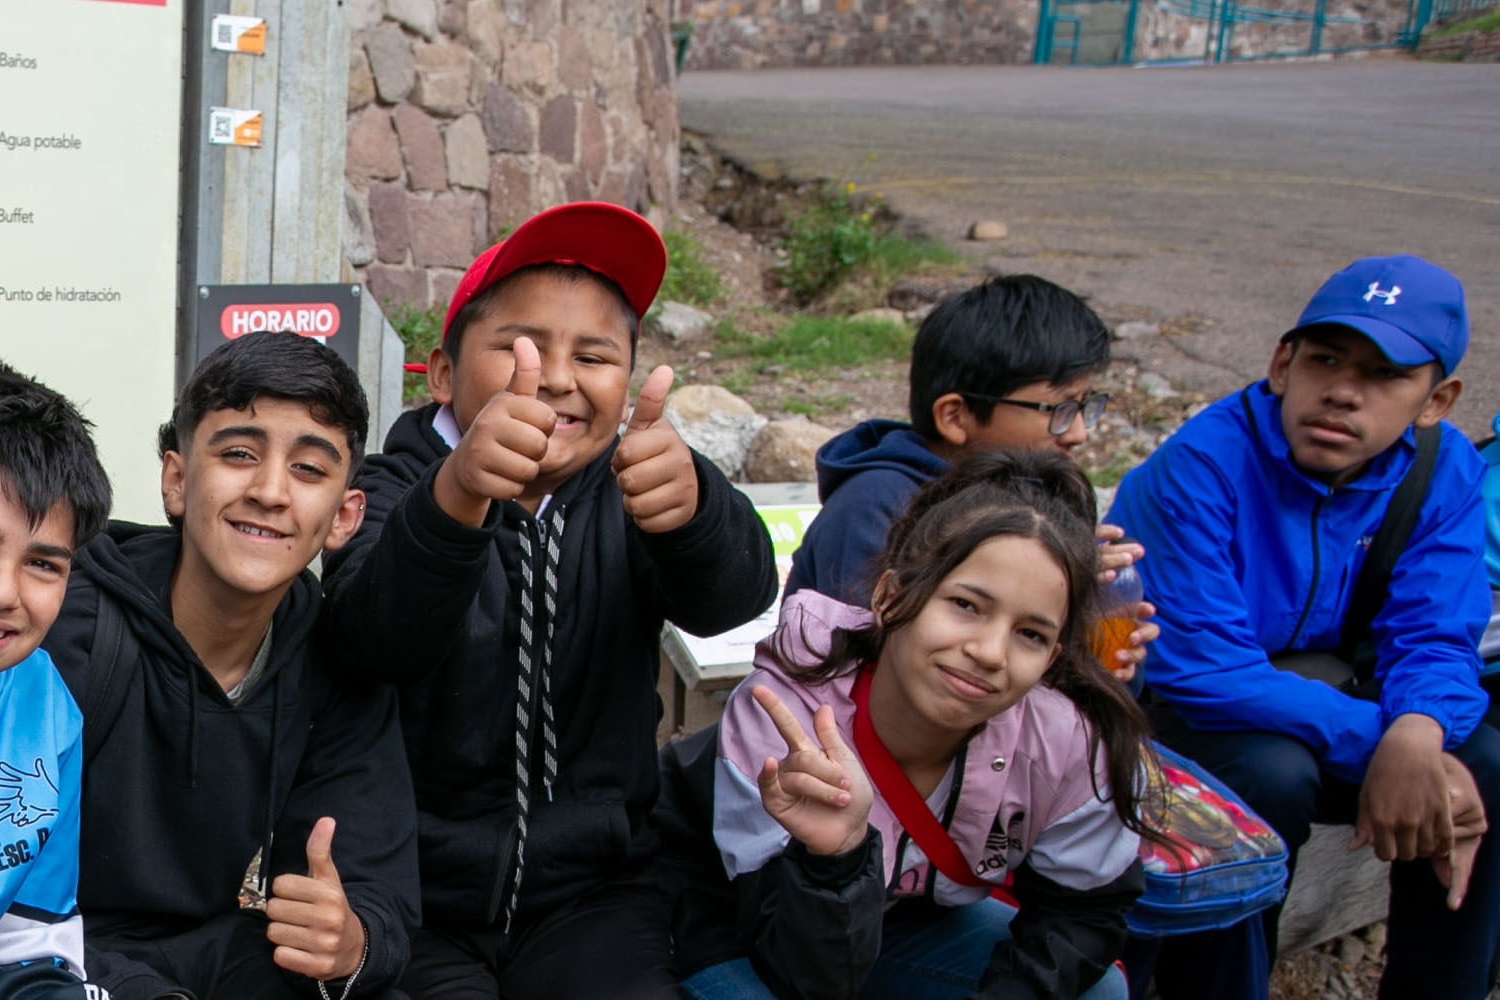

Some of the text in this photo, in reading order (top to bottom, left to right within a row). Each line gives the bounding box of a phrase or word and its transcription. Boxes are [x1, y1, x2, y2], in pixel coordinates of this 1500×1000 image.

[33, 134, 82, 152] potable
[36, 286, 53, 302] de
[55, 286, 122, 302] hidratación
[232, 308, 334, 335] HORARIO
